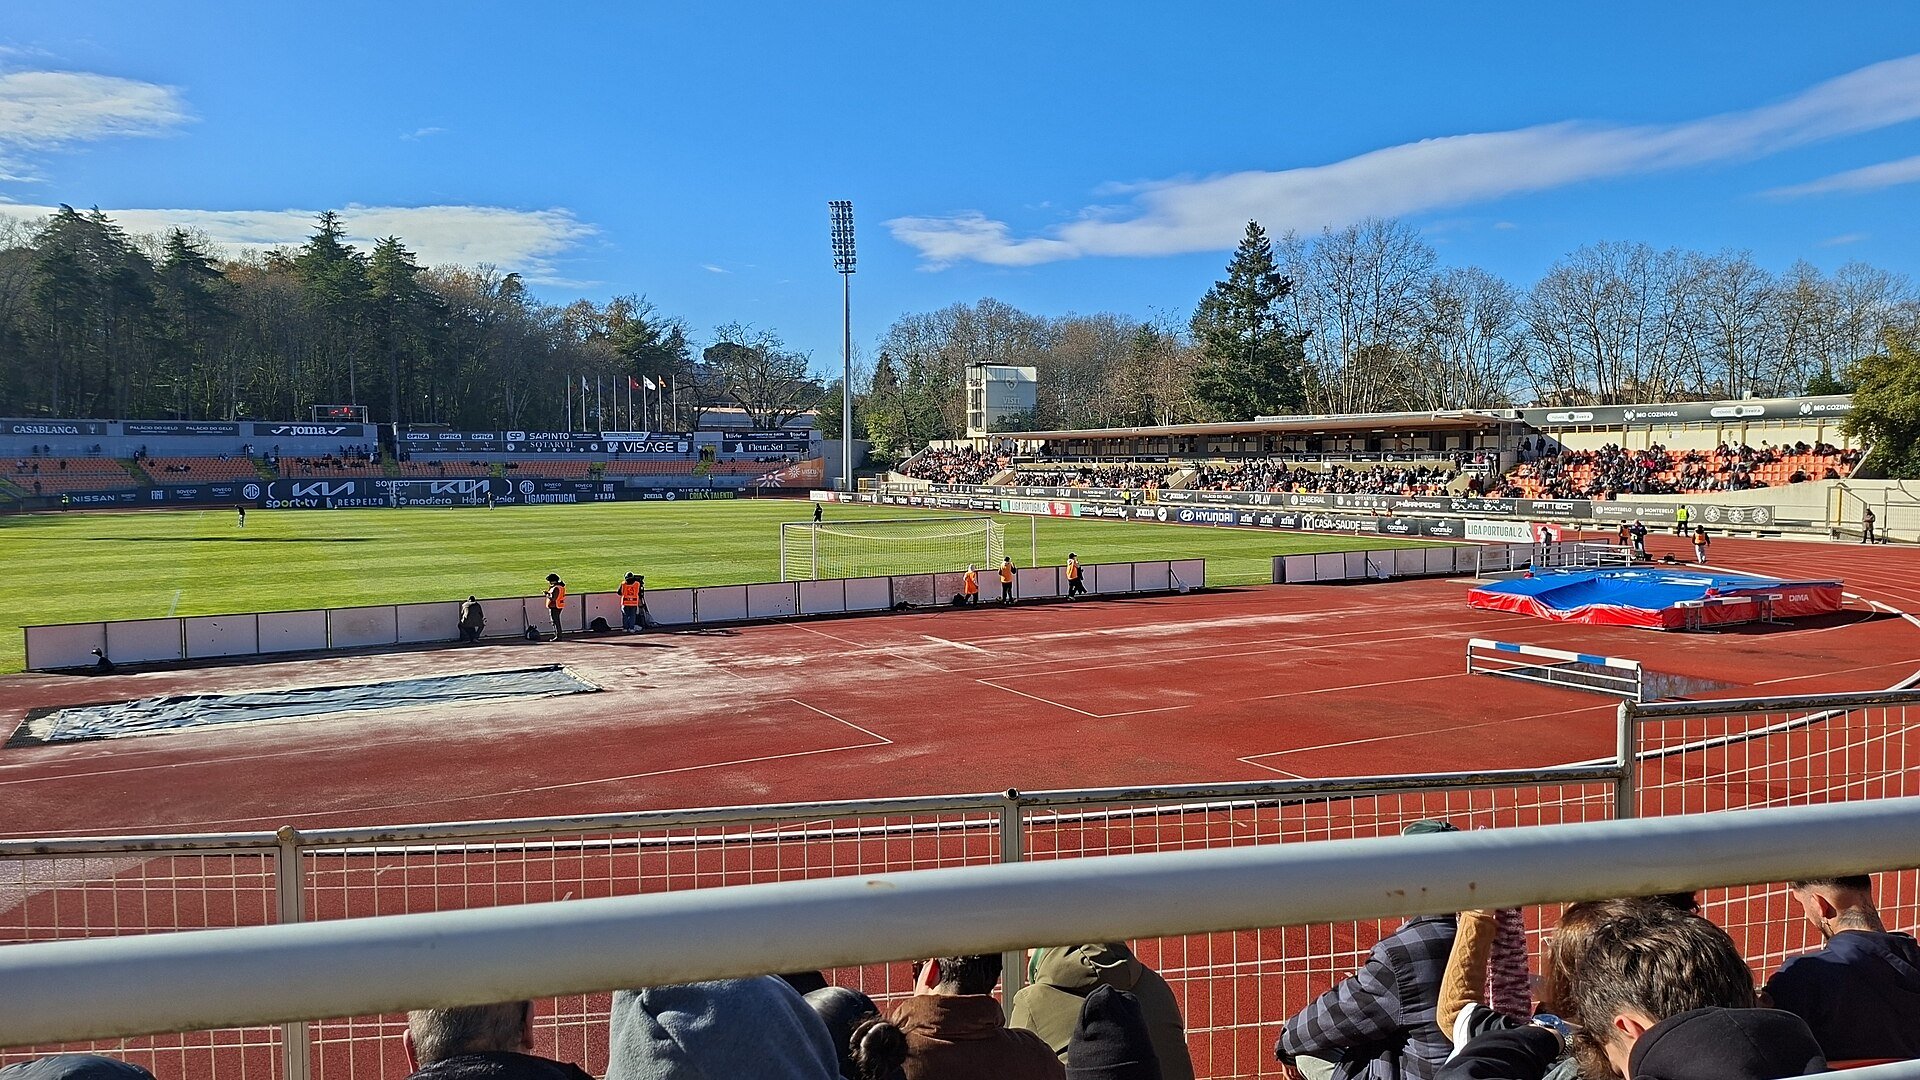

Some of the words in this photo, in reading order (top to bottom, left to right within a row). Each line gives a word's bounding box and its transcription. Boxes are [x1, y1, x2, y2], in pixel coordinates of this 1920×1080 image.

[13, 425, 79, 435] CASABLANCA
[529, 432, 570, 440] SAPINTO
[622, 441, 674, 452] VISAGE
[292, 481, 355, 496] KIA
[431, 480, 490, 493] KIA
[244, 486, 258, 499] MG
[72, 495, 115, 503] NISSAN
[1248, 494, 1254, 503] 2
[1255, 495, 1272, 505] PLAY
[1300, 496, 1326, 504] EMBEIRAL
[1196, 512, 1233, 523] HYUNDAI
[1314, 519, 1333, 529] CASA
[1467, 525, 1481, 535] LIGA
[1483, 525, 1517, 538] PORTUGAL
[1517, 528, 1523, 538] 2
